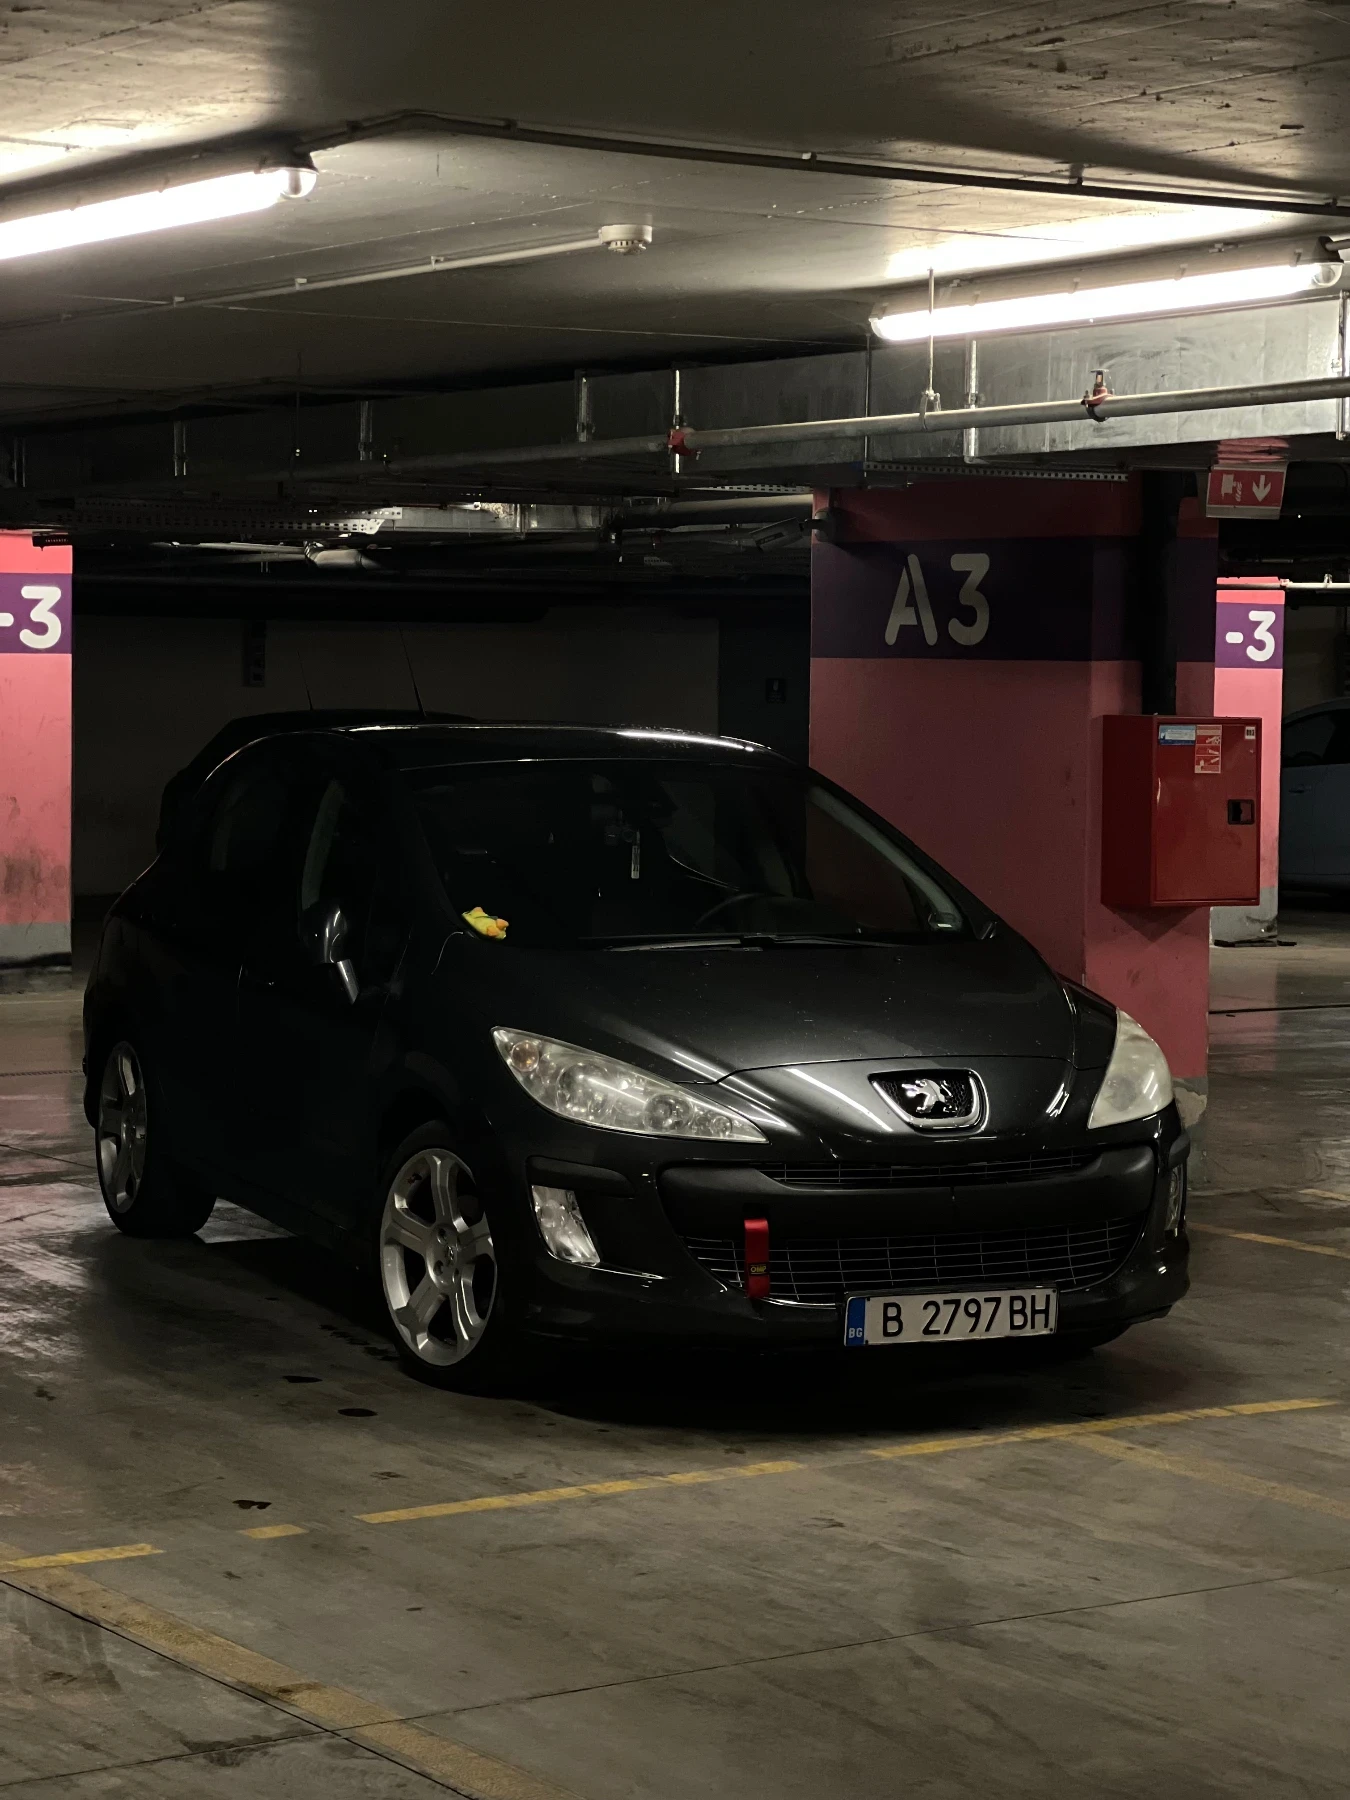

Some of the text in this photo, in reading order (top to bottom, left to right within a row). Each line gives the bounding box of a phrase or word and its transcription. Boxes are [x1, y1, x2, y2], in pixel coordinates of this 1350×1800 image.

[1225, 610, 1276, 662] -3
[848, 1327, 863, 1339] BG
[882, 1294, 1051, 1338] B 2797 BH
